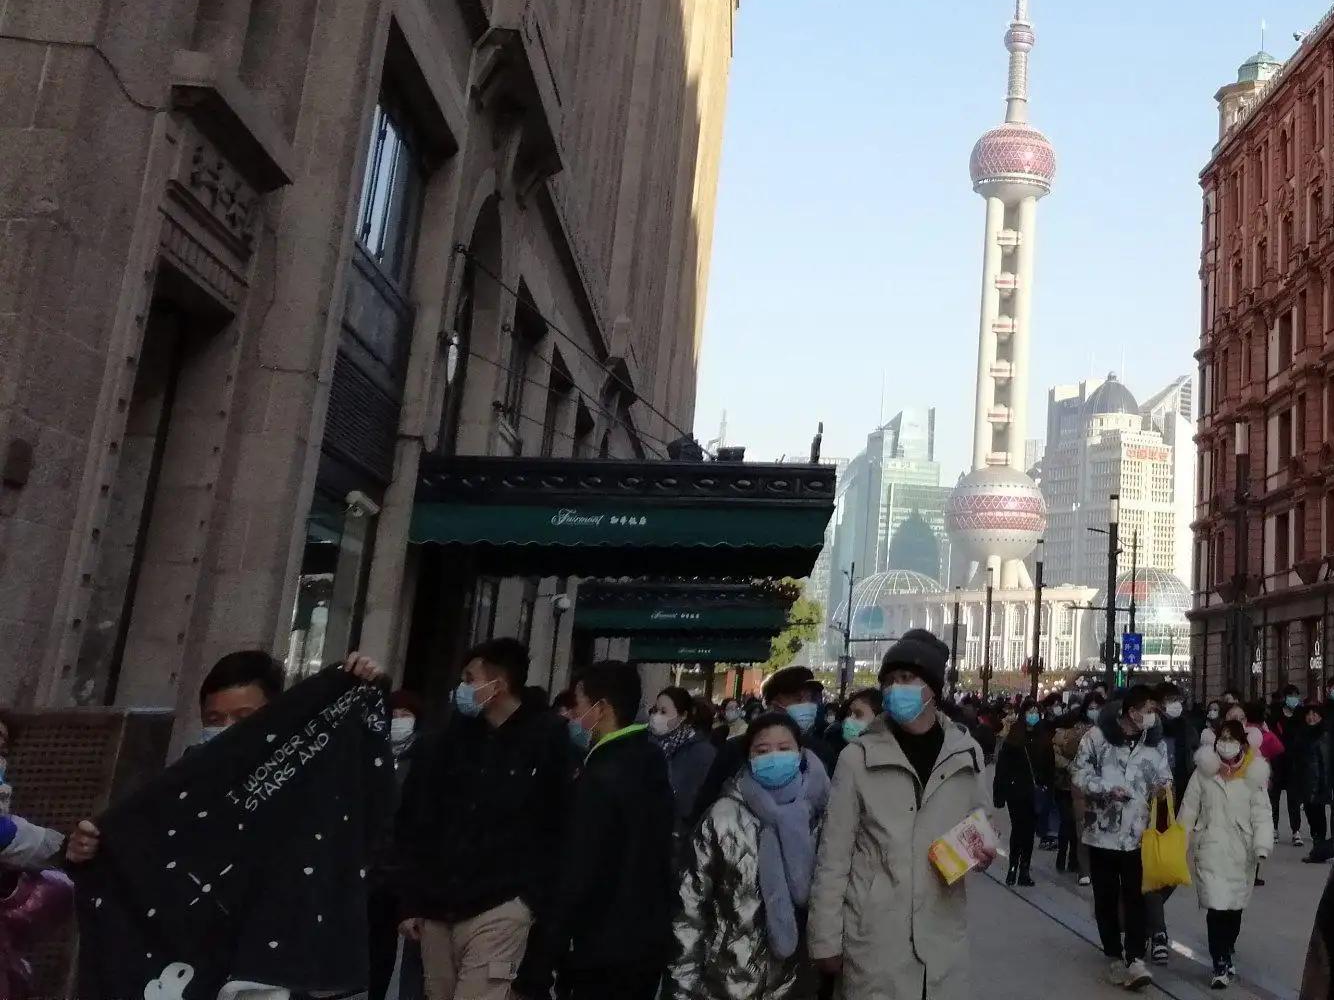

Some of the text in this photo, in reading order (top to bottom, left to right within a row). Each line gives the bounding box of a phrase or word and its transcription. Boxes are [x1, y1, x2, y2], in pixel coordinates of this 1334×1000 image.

[225, 790, 240, 805] I
[243, 734, 305, 792] WONDER
[304, 719, 321, 737] IF
[245, 732, 330, 812] STARS AND
